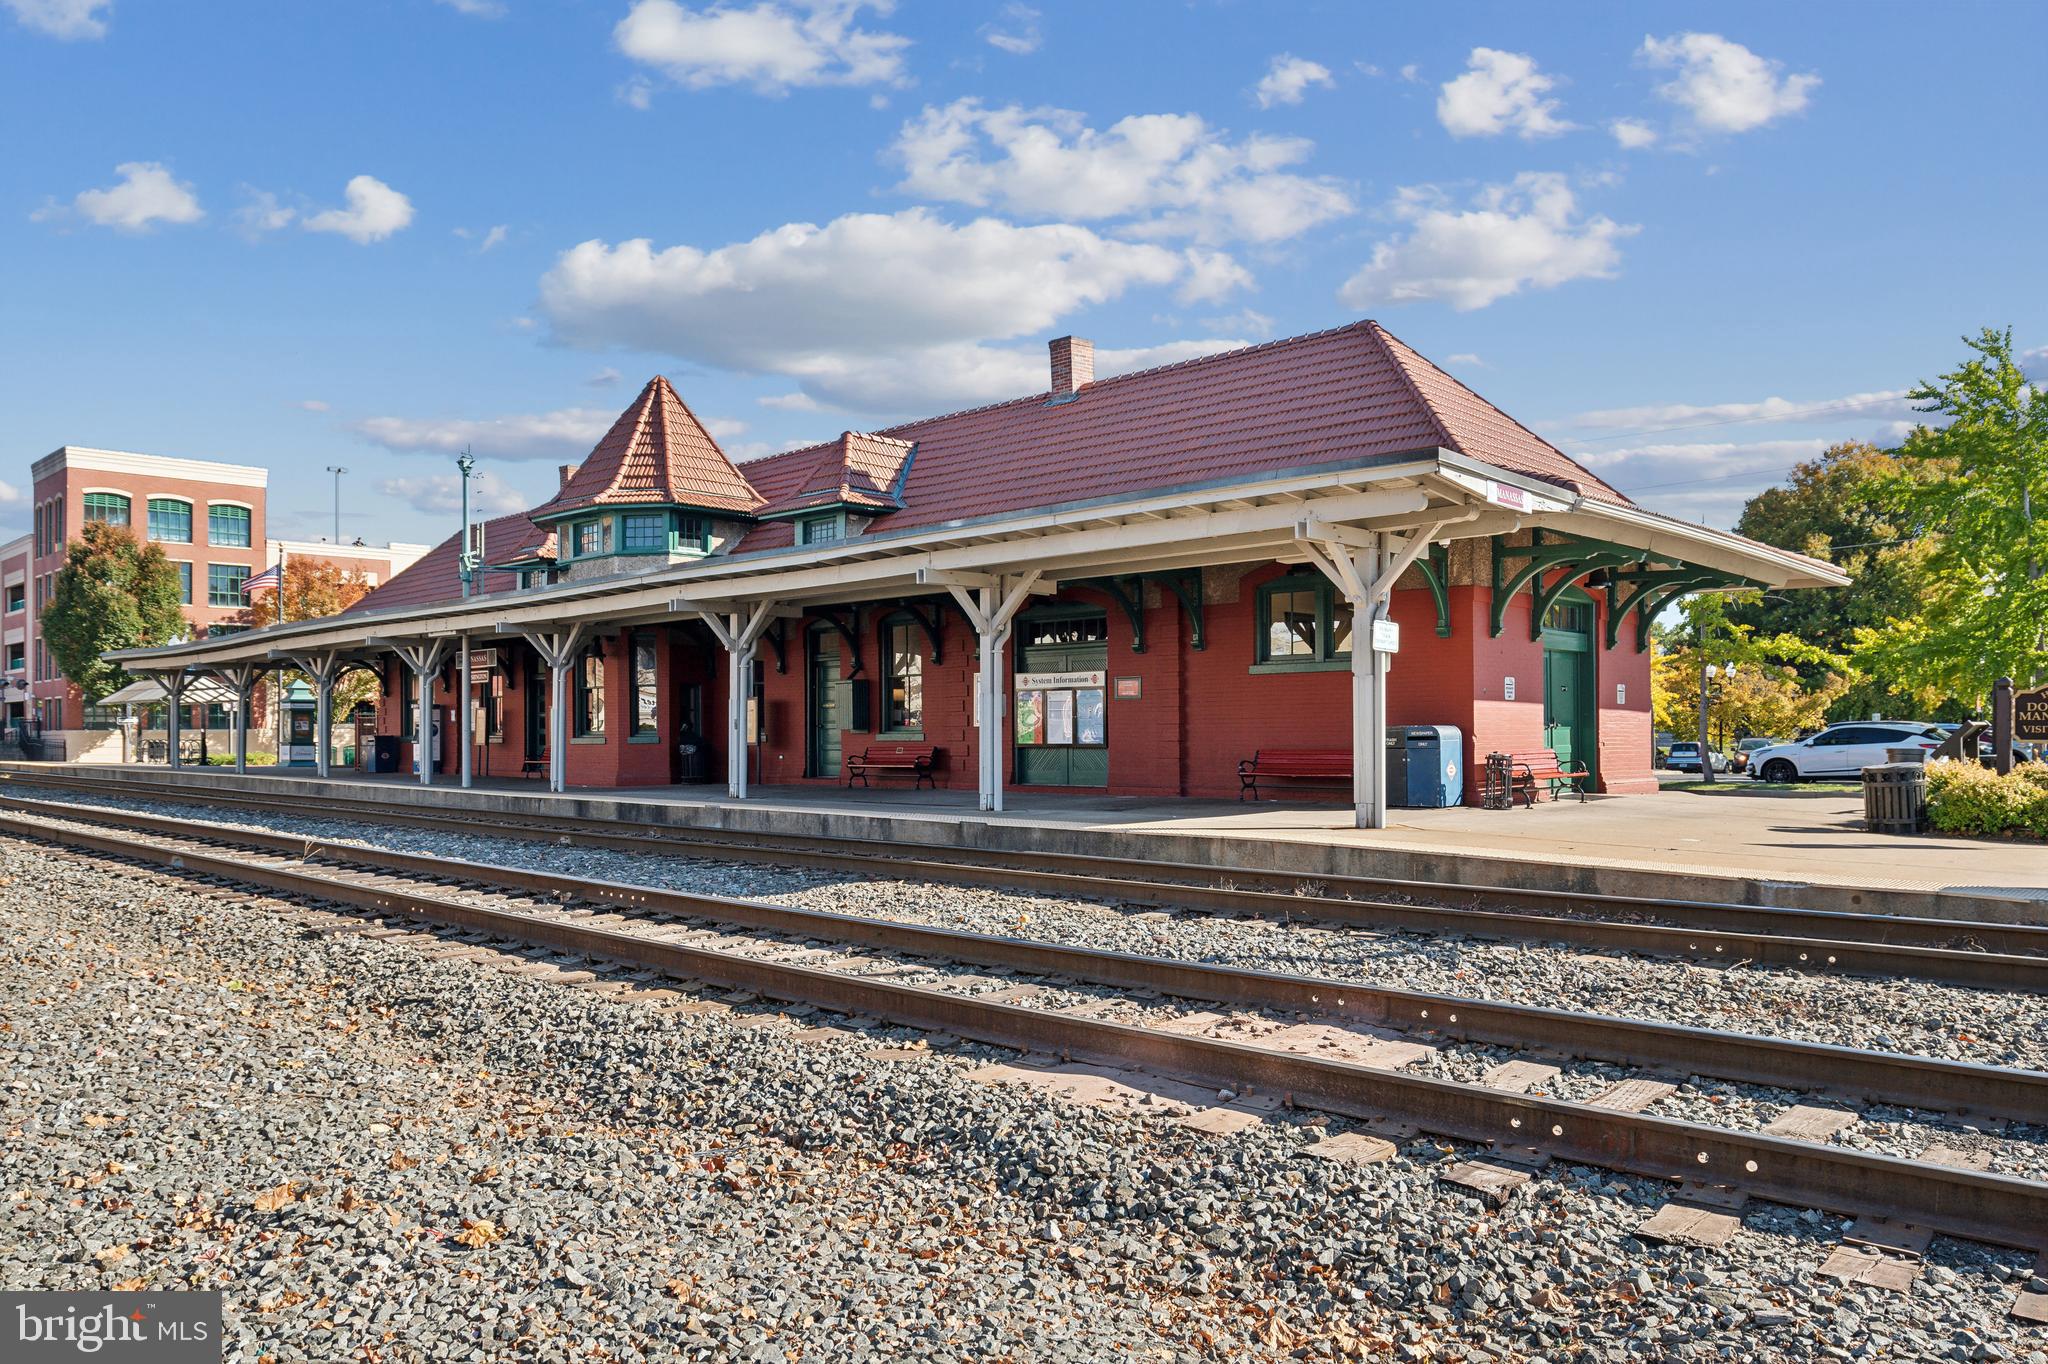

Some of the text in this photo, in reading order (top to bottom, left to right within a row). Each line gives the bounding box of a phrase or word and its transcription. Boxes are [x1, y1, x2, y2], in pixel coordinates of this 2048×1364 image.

[1031, 676, 1089, 687] System Information
[2026, 702, 2048, 712] DO
[2019, 711, 2048, 721] MAN
